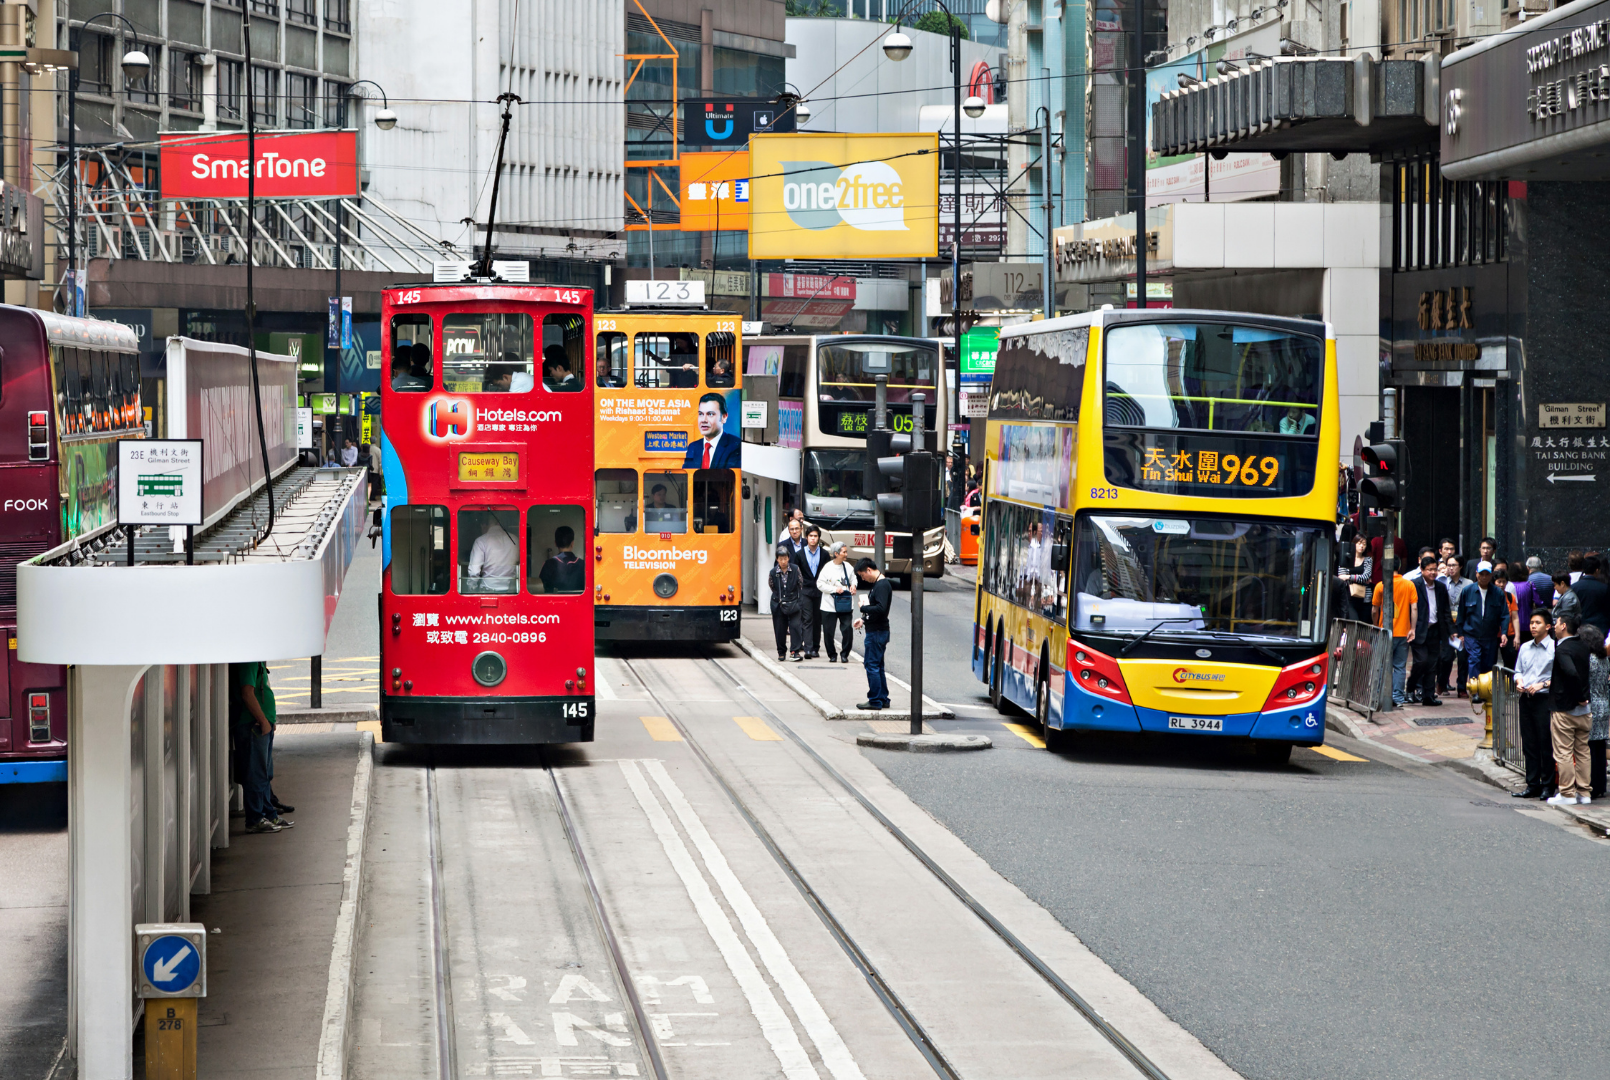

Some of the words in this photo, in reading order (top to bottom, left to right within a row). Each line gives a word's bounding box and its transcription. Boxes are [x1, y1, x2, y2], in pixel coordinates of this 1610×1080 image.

[191, 152, 326, 179] SmarTone
[783, 174, 904, 209] one2free
[1004, 272, 1024, 294] 112
[554, 290, 580, 304] 145
[645, 282, 690, 300] 123
[397, 291, 421, 304] 145
[597, 320, 616, 331] 123
[716, 321, 735, 332] 123
[600, 398, 614, 408] ON
[616, 398, 635, 408] THE
[637, 399, 665, 408] MOVE
[667, 399, 691, 408] ASIA
[1545, 405, 1569, 413] Gilman
[1577, 405, 1600, 413] Street
[476, 408, 562, 422] Hotels.com
[615, 407, 646, 415] Rishaad
[648, 407, 680, 415] Salamat
[600, 415, 628, 423] Weekdays
[647, 432, 667, 440] Western
[669, 432, 687, 440] Market
[130, 450, 145, 460] 23E
[1144, 447, 1219, 471] 天水圍
[1535, 451, 1551, 460] TAI
[1553, 451, 1579, 460] SANG
[1581, 451, 1606, 460] BANK
[461, 456, 500, 468] Causeway
[502, 455, 518, 467] Bay
[1548, 462, 1594, 471] BUILDING
[1141, 466, 1160, 481] Tin
[1164, 467, 1193, 482] Shui
[1197, 470, 1221, 484] Wai
[1221, 454, 1279, 487] 969
[1090, 487, 1118, 499] 8213
[4, 498, 49, 512] FOOK
[167, 510, 180, 518] Stop
[623, 545, 708, 564] Bloomberg
[624, 562, 676, 570] TELEVISION
[412, 612, 440, 627] 瀏覽
[445, 613, 560, 625] www.hotels.com
[719, 609, 738, 622] 123
[426, 630, 468, 645] 或致電
[473, 632, 547, 644] 2840-0896
[1180, 672, 1211, 681] CITYBUS
[562, 702, 588, 718] 145
[1170, 718, 1186, 728] RL
[1190, 718, 1221, 730] 3944
[166, 1008, 176, 1018] B
[158, 1020, 182, 1030] 278
